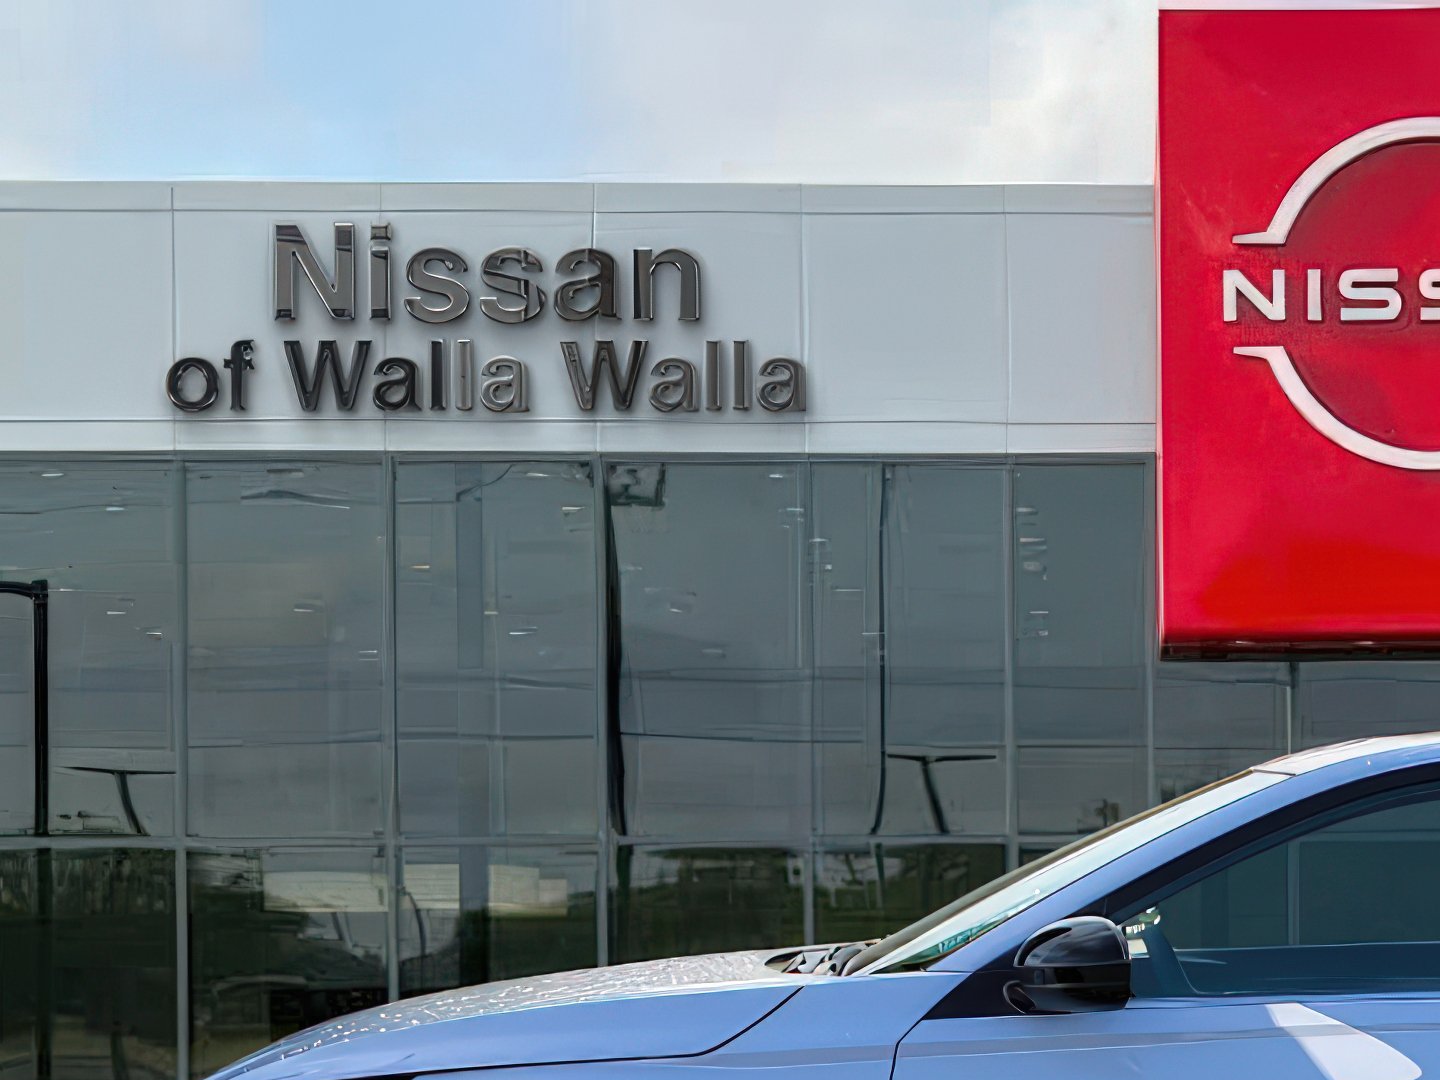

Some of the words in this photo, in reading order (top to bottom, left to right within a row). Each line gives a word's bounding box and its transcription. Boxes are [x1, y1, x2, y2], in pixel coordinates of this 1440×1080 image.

[274, 221, 704, 323] Nissan
[165, 339, 255, 413] of
[282, 340, 530, 412] Walla
[559, 340, 808, 413] Walla
